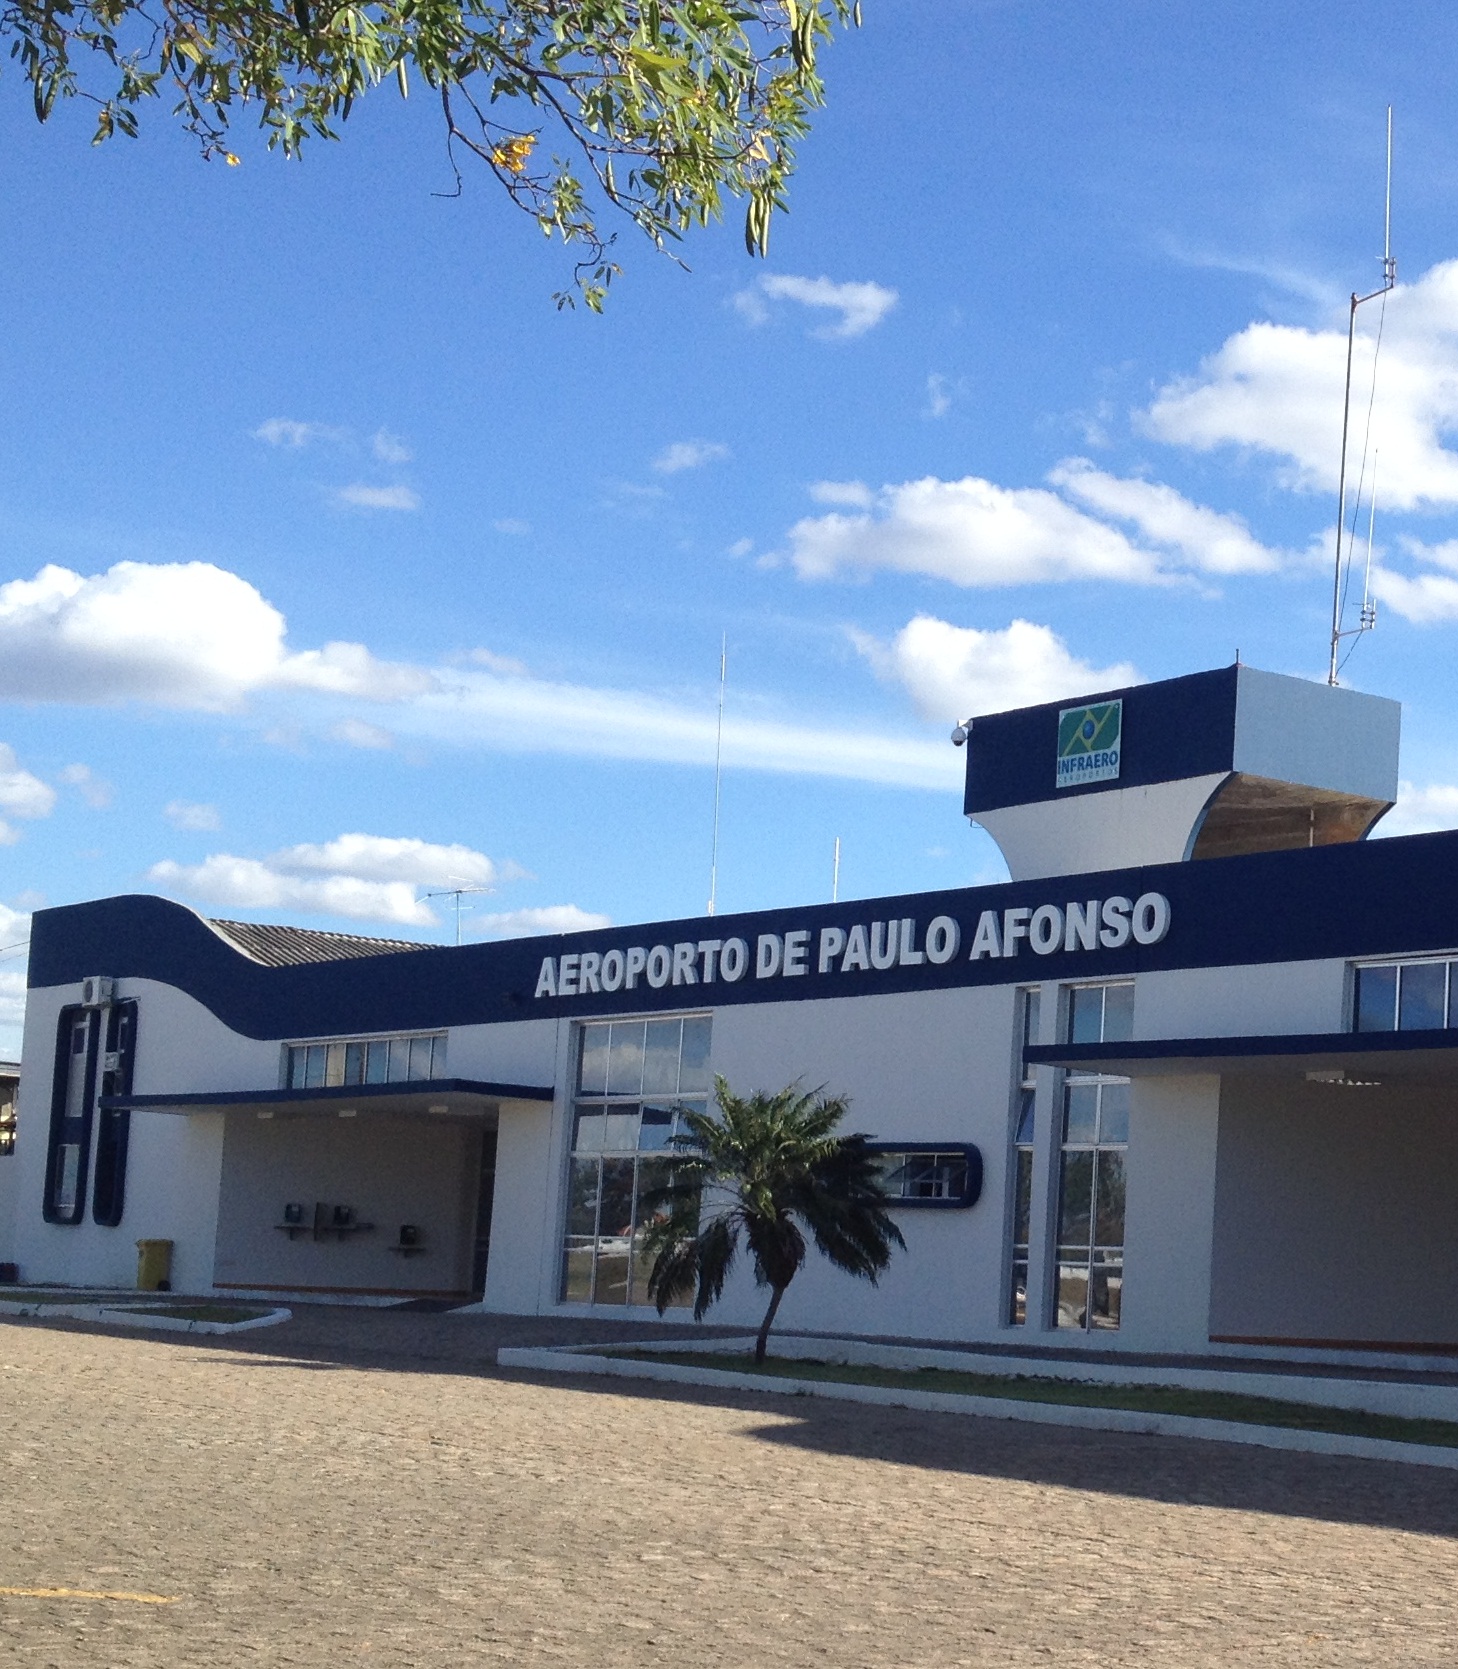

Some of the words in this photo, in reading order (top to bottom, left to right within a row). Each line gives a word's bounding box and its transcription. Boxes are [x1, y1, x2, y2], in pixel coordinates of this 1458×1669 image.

[1058, 751, 1118, 775] INFRAERO
[534, 937, 748, 997] AEROPORTO
[756, 930, 811, 979] DE
[818, 915, 960, 973] PAULO
[969, 892, 1171, 960] AFONSO
